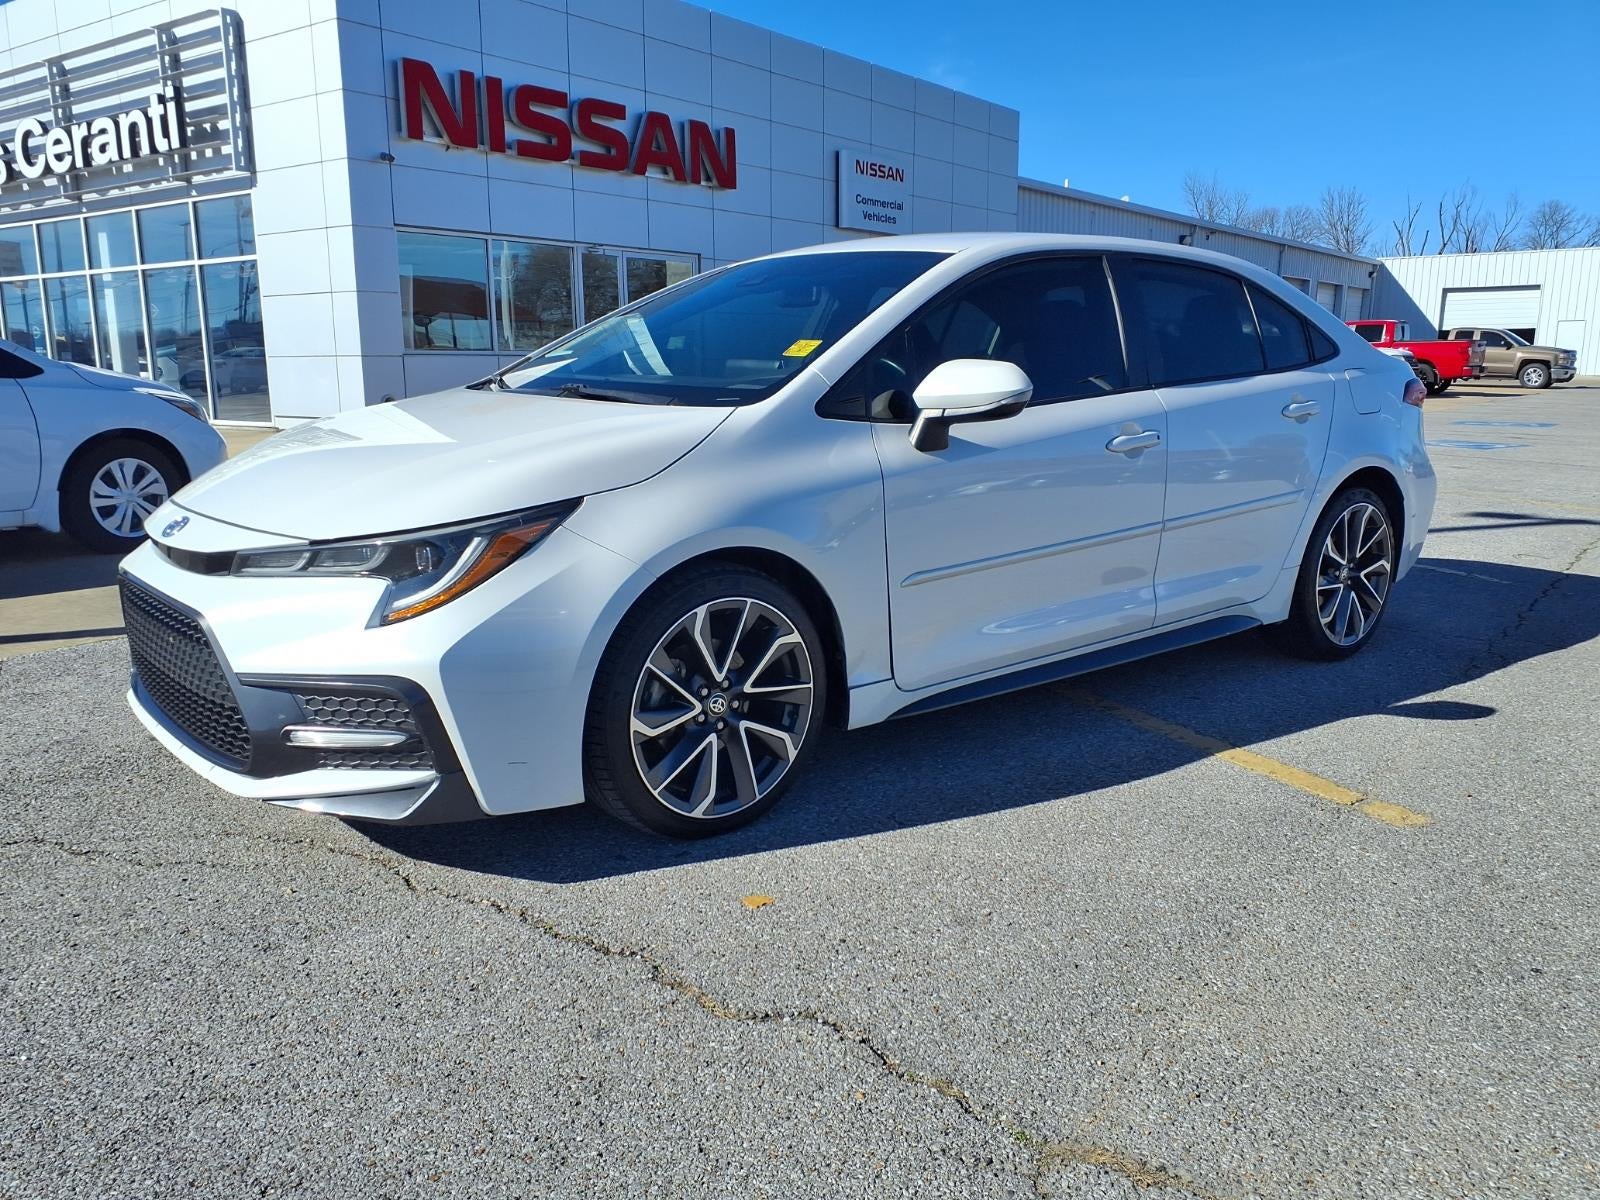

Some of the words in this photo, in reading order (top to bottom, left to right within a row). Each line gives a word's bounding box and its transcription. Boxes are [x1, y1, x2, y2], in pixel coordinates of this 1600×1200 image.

[14, 84, 182, 179] Ceranti
[400, 56, 737, 190] NISSAN
[855, 159, 905, 183] NISSAN
[855, 193, 904, 211] Commercial
[862, 210, 897, 225] Vehicles
